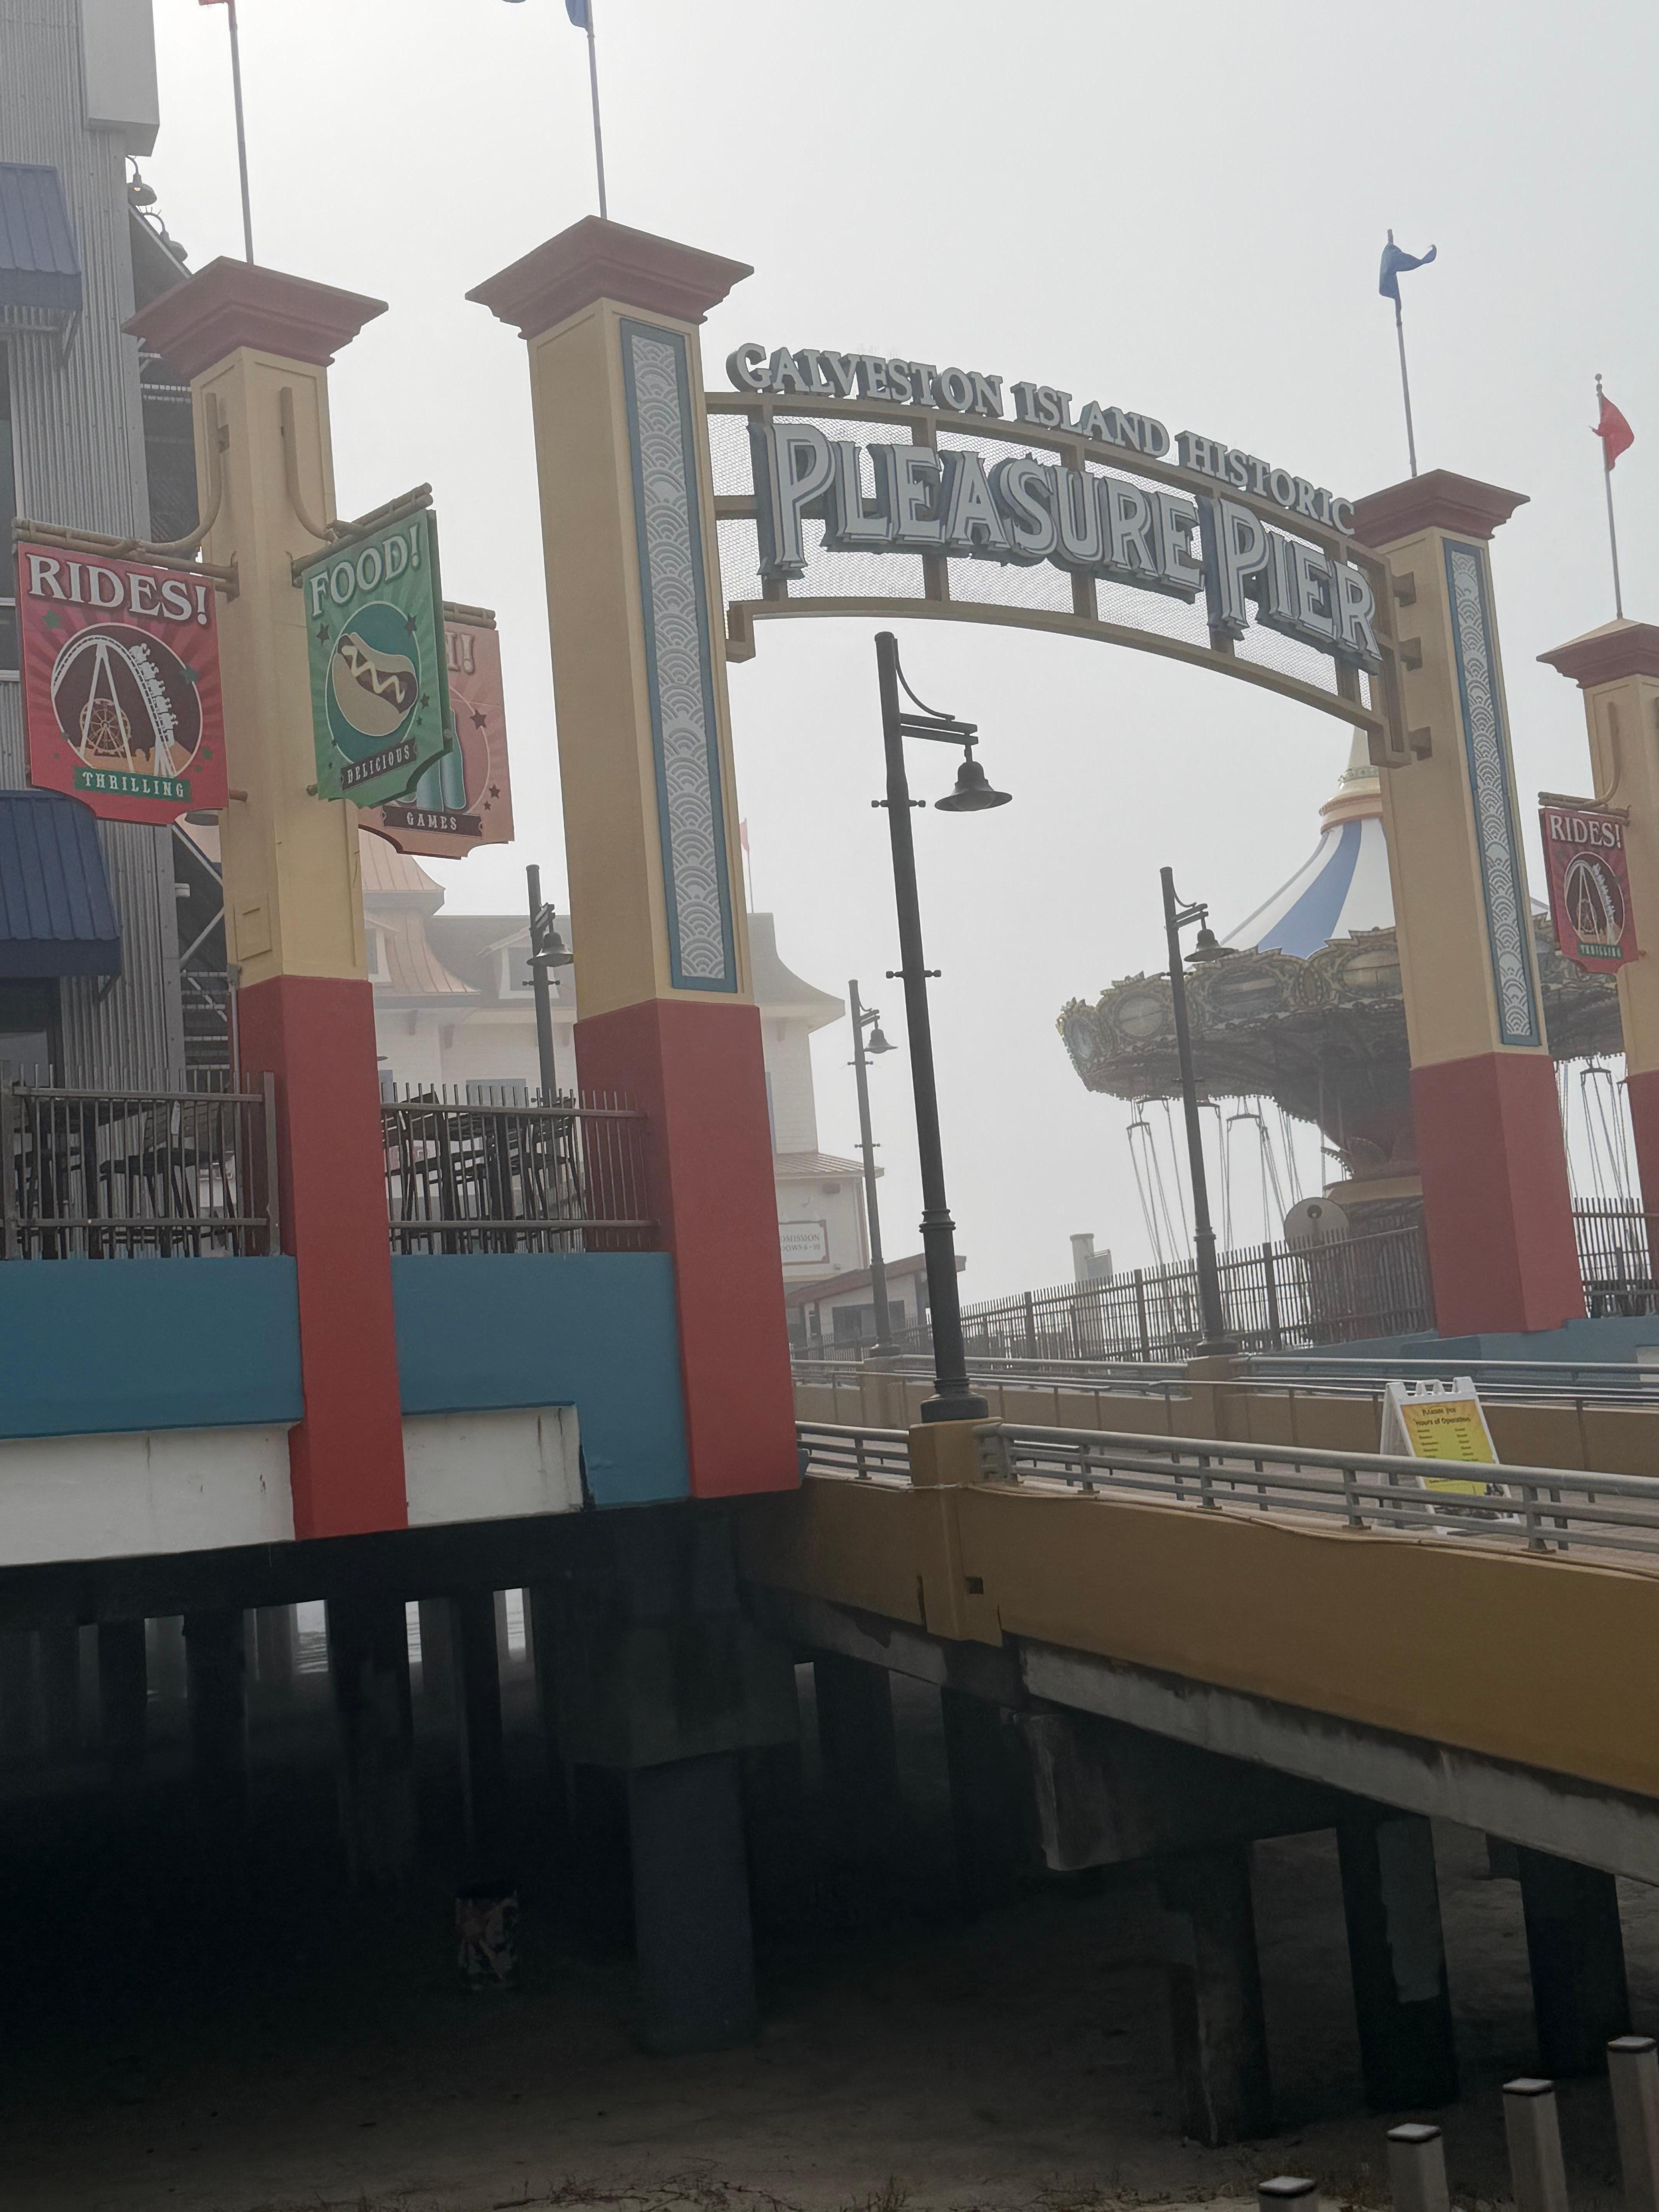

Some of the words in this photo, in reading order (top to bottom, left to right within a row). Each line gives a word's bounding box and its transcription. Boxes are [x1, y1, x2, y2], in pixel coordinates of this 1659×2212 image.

[726, 342, 1004, 417] GALVESTON
[1010, 381, 1170, 459] ISLAND
[1175, 430, 1355, 535] HISTORIC
[309, 522, 421, 617] FOOD!
[747, 423, 1205, 603] PLEASURE
[1197, 496, 1383, 672] PIER
[26, 554, 208, 625] RIDES!
[82, 771, 184, 798] THRILLING
[347, 744, 410, 785] DELICIOUS
[406, 811, 457, 831] GAMES
[1549, 814, 1621, 849] RIDES!
